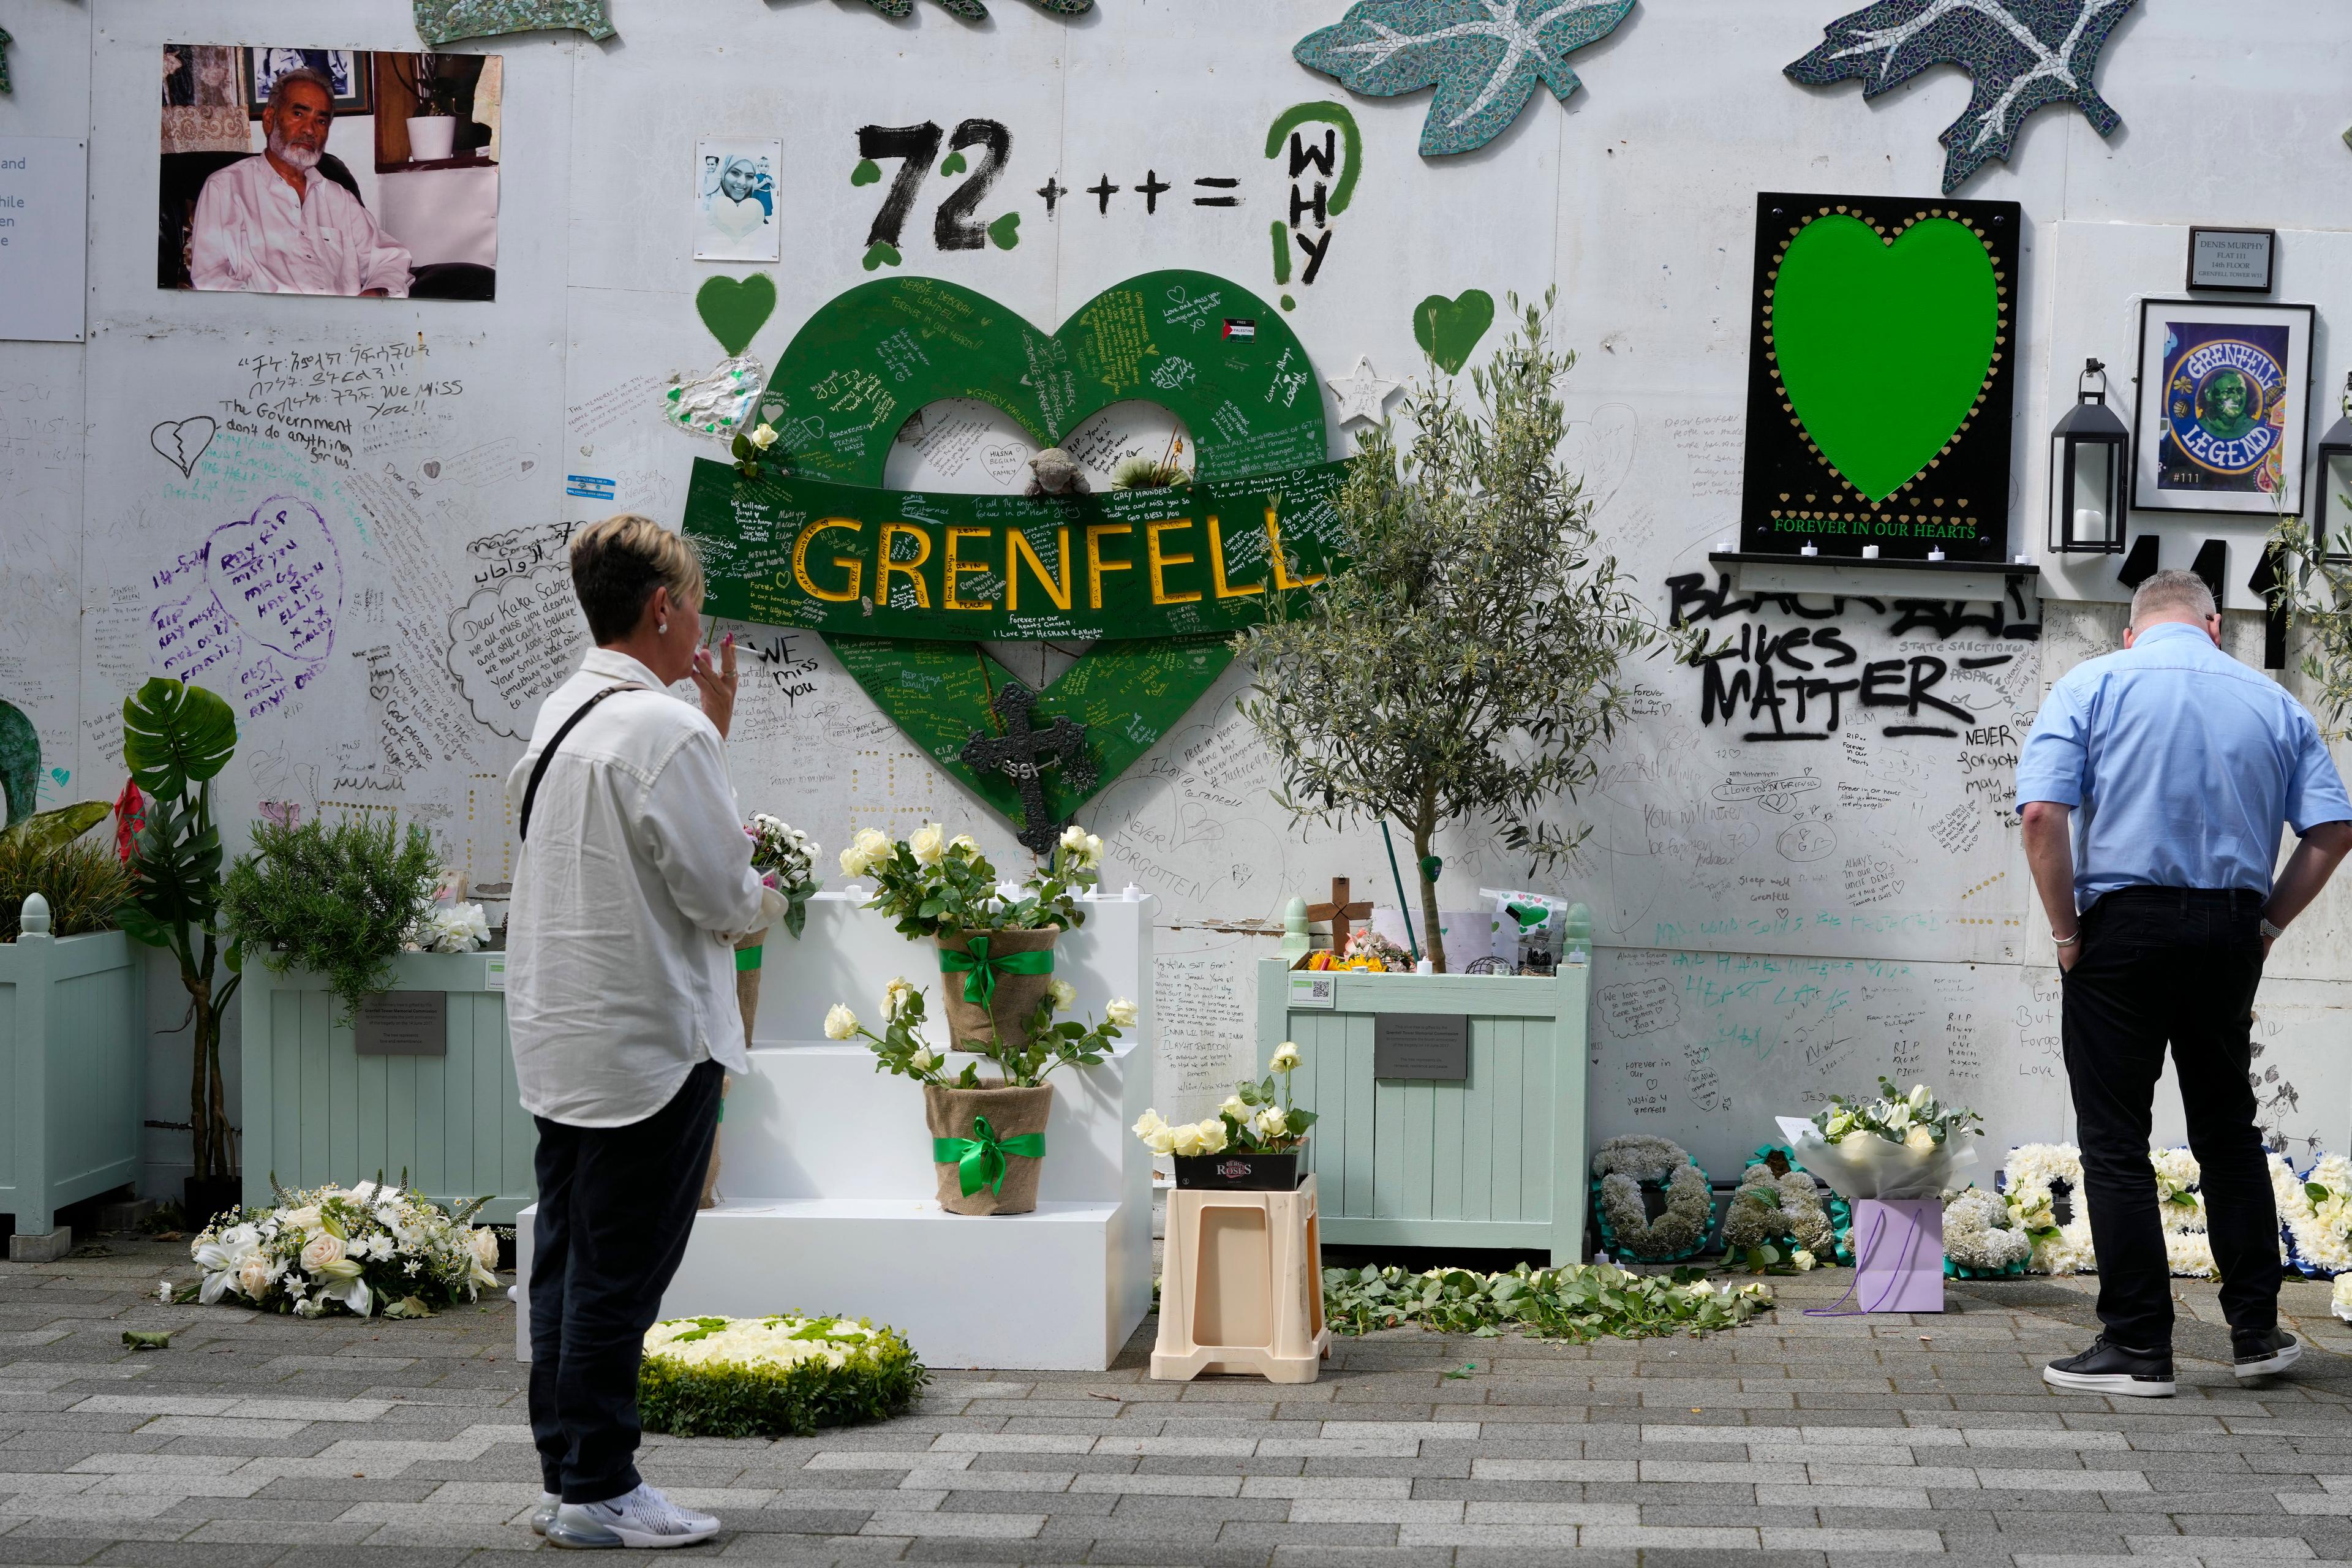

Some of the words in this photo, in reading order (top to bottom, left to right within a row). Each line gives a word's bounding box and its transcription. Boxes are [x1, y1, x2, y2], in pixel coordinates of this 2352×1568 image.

[1, 157, 26, 169] and
[856, 118, 1013, 251] 72
[1289, 129, 1335, 285] WHY
[938, 290, 974, 317] DEBORAH
[1180, 300, 1193, 311] and
[1208, 290, 1221, 301] you
[2188, 344, 2276, 391] GRENFELL
[973, 388, 1007, 407] GARY
[219, 399, 252, 416] The
[257, 405, 353, 435] Government
[227, 420, 257, 437] don't
[265, 423, 280, 439] do
[288, 429, 353, 457] anything
[1246, 429, 1287, 444] NEIGHBOURS
[2182, 424, 2271, 466] LEGEND
[311, 448, 331, 464] for
[1211, 460, 1237, 469] Forever
[2173, 473, 2199, 483] #111
[1112, 491, 1133, 502] GARY
[1136, 486, 1173, 498] MAUNDERS
[1167, 499, 1179, 508] you
[1774, 519, 1847, 534] FOREVER
[1852, 522, 1869, 535] IN
[1874, 522, 1909, 537] OUR
[1914, 524, 1976, 540] HEARTS
[797, 526, 817, 566] MAUNDERS
[880, 526, 889, 561] LAMPRELL
[793, 507, 1325, 611] GRENFELL
[878, 563, 886, 597] DEBBIE
[463, 612, 495, 641] Dear
[497, 595, 535, 618] Kaka
[484, 632, 499, 647] all
[499, 619, 522, 637] miss
[524, 608, 540, 627] you
[477, 650, 496, 666] and
[499, 636, 514, 654] still
[544, 607, 578, 628] believe
[1690, 623, 1857, 670] LIVES
[1899, 641, 1945, 653] STATE
[500, 649, 522, 665] have
[526, 637, 543, 655] lost
[517, 654, 543, 673] smile
[544, 643, 562, 657] was
[748, 635, 804, 664] WE
[540, 660, 551, 670] to
[550, 652, 570, 668] look
[543, 675, 554, 689] all
[1634, 684, 1665, 696] Forever
[1702, 655, 1976, 733] MATTER
[1845, 712, 1876, 726] BLM
[1842, 741, 1866, 751] Forever
[1966, 725, 2018, 747] NEVER
[1184, 744, 1204, 761] rest
[1205, 737, 1215, 748] in
[1197, 752, 1218, 771] gone
[1221, 739, 1238, 754] but
[1715, 750, 1727, 758] 72
[1204, 760, 1228, 777] never
[1847, 756, 1869, 767] hearts
[1838, 782, 1860, 792] Forever
[1125, 805, 1166, 853] NEVER
[1110, 831, 1227, 903] FORGOTTEN
[1770, 876, 1790, 887] well
[1604, 992, 1616, 1002] We
[1623, 990, 1639, 999] love
[1643, 989, 1657, 998] you
[1646, 998, 1666, 1008] never
[2016, 1005, 2054, 1028] But
[1661, 1058, 1671, 1067] in
[2019, 1063, 2055, 1077] Love
[1216, 1164, 1251, 1175] ROSES
